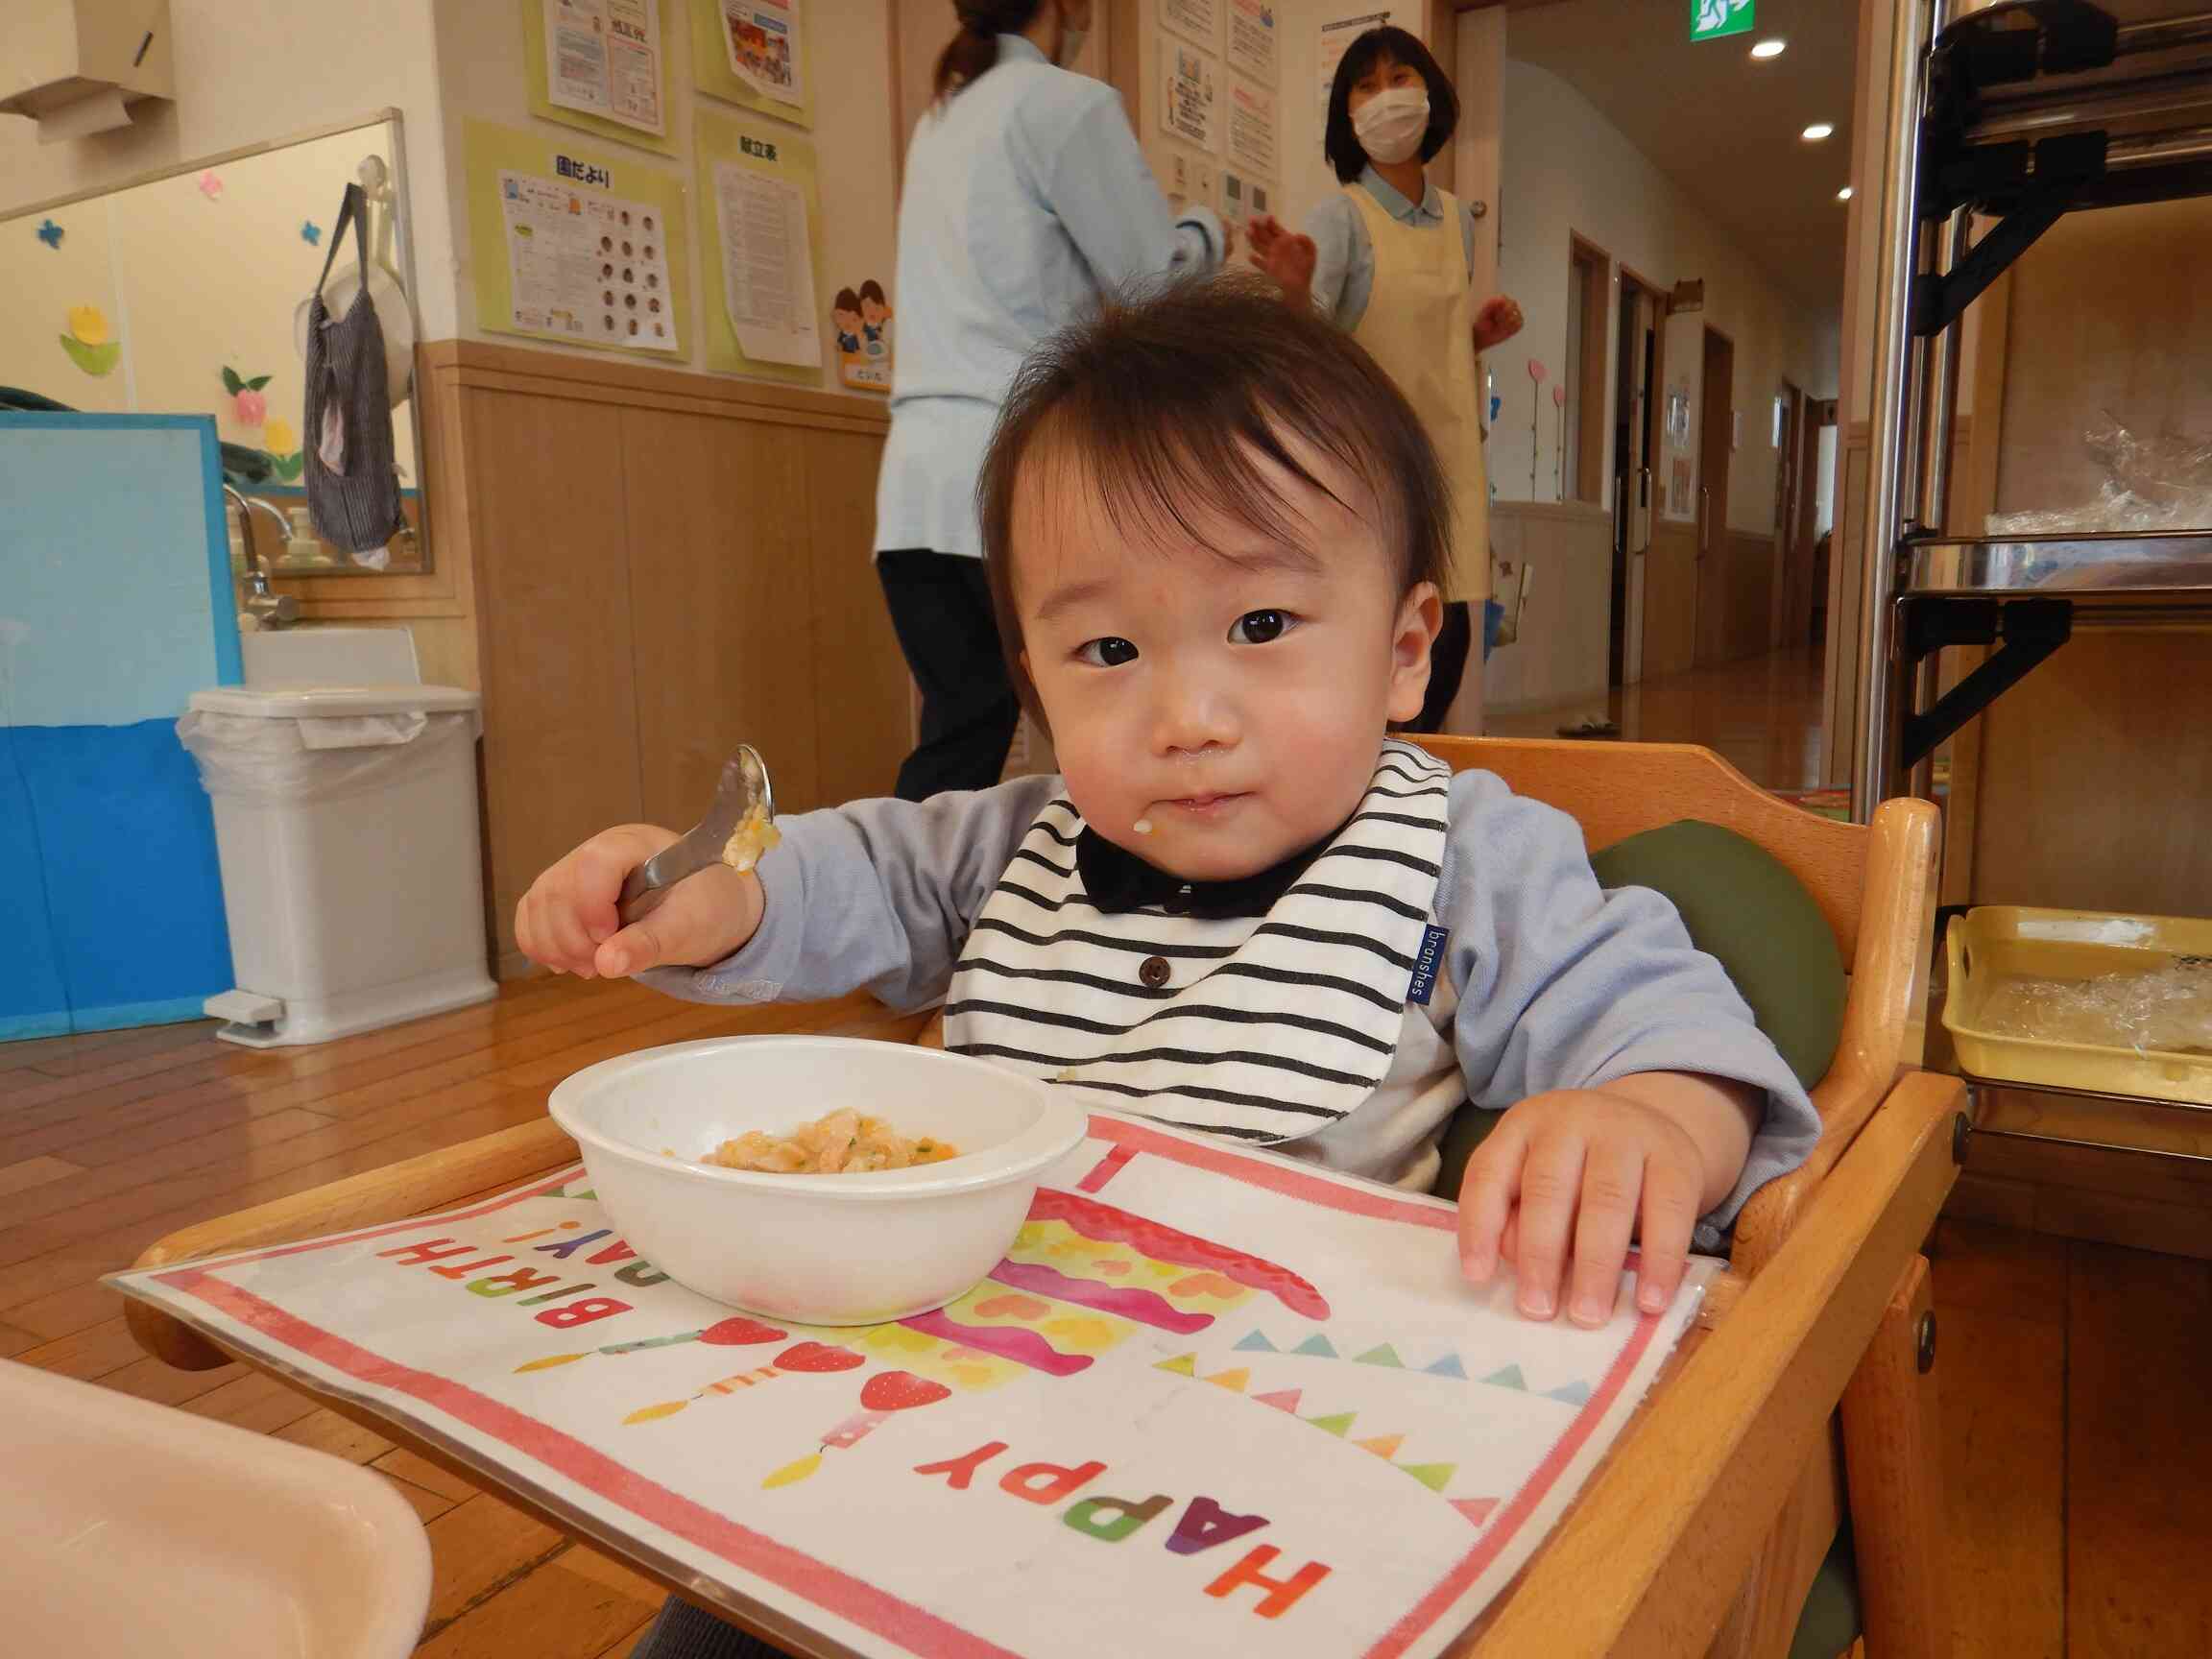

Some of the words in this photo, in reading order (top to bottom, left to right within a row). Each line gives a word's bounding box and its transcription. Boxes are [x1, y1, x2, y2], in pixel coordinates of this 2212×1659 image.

[1412, 931, 1446, 996] branshes
[375, 1238, 634, 1329] BIRTH
[913, 1440, 1333, 1620] HAPPY
